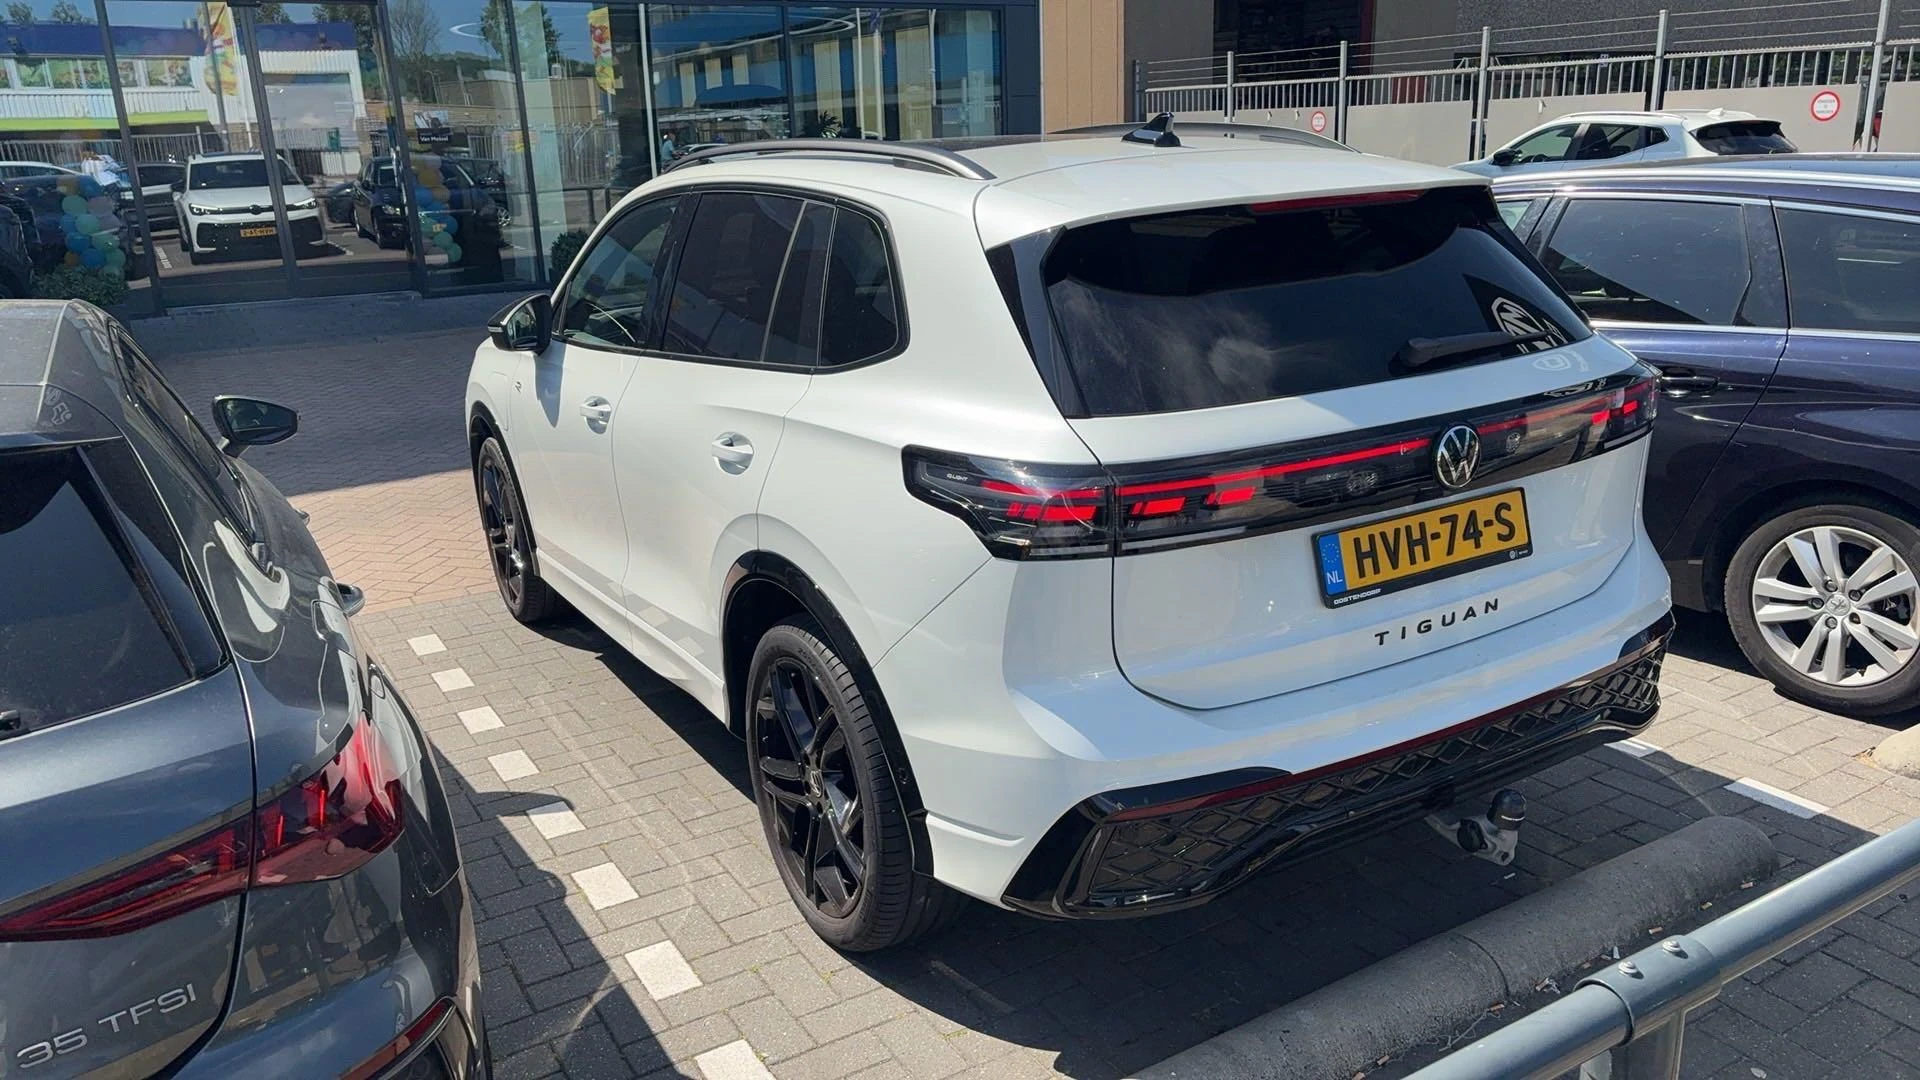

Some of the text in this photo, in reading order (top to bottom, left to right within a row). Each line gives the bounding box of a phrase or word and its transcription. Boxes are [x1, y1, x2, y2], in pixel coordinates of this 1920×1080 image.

[1326, 502, 1516, 584] NL HVH-74-S
[1374, 598, 1498, 646] TIGUAN
[16, 983, 197, 1069] 35 TFSI
